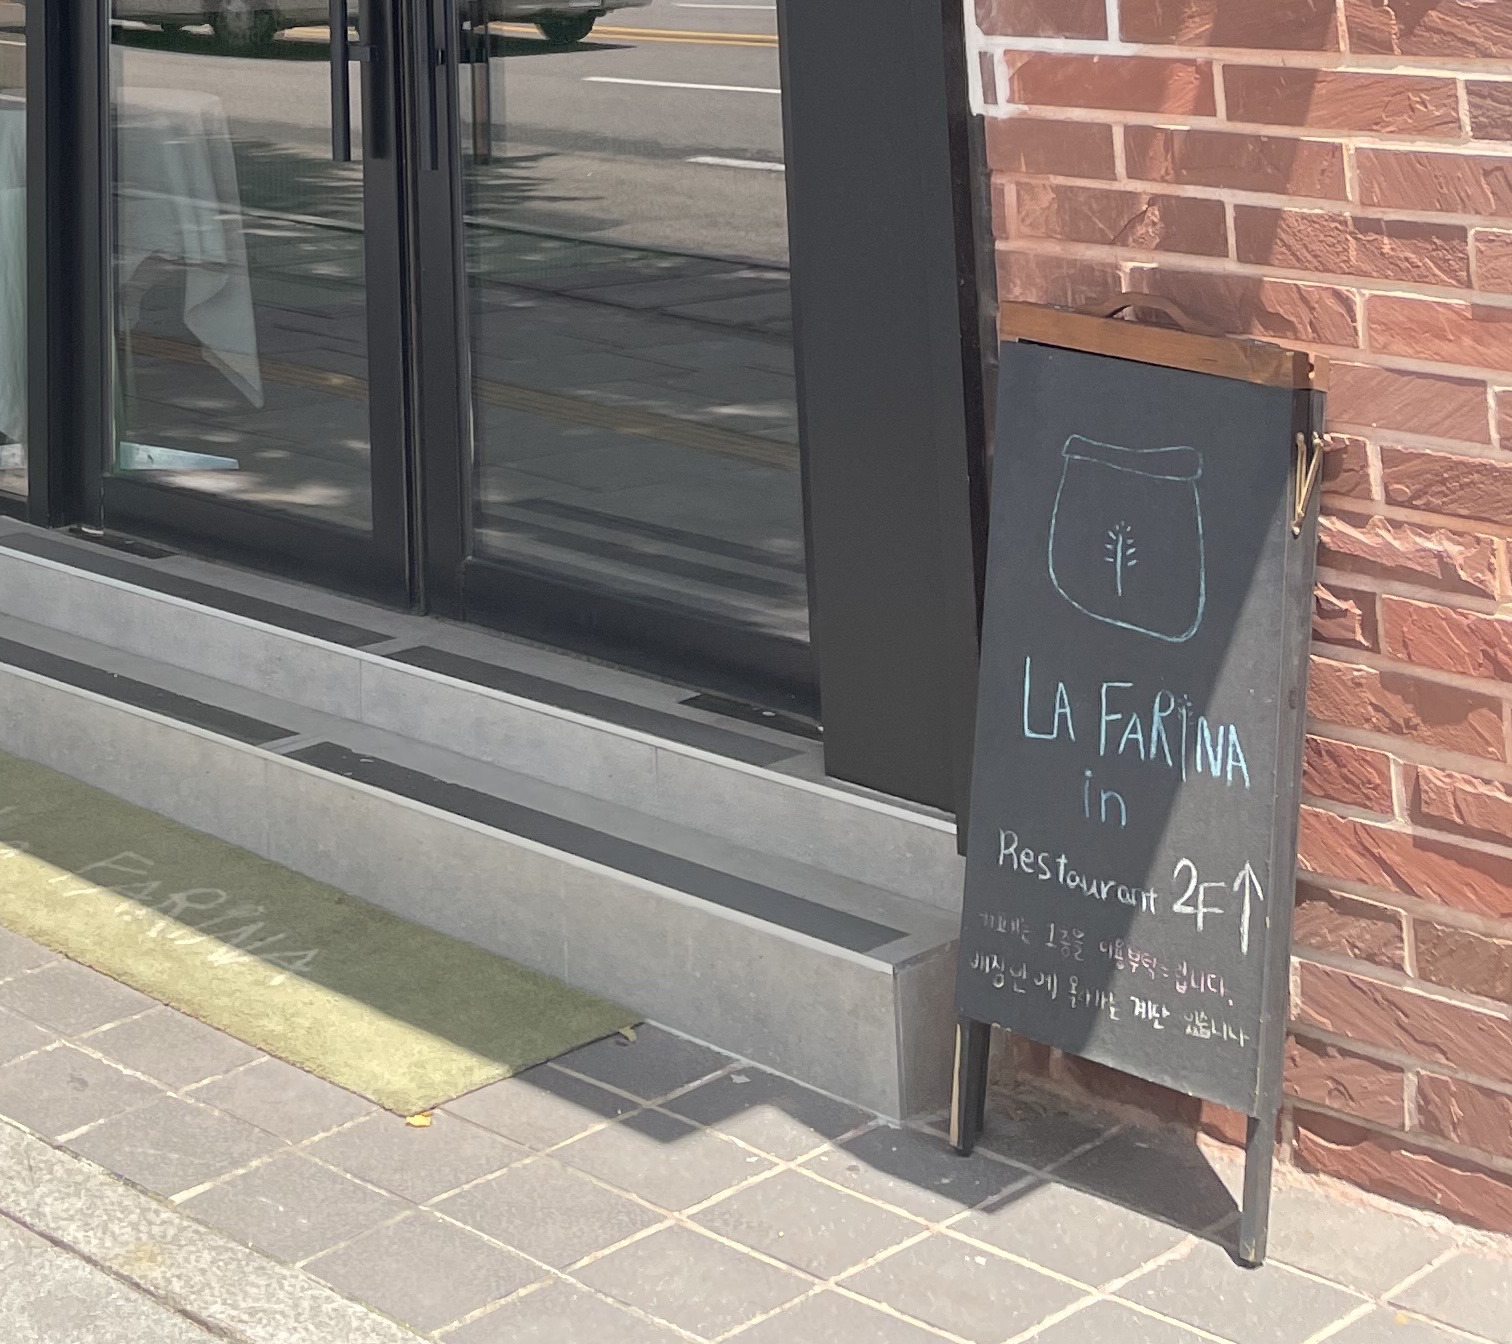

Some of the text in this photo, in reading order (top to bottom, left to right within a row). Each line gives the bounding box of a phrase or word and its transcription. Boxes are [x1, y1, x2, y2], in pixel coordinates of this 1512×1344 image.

[1023, 656, 1076, 742] LA
[1083, 769, 1128, 828] in
[1171, 857, 1227, 932] 2F
